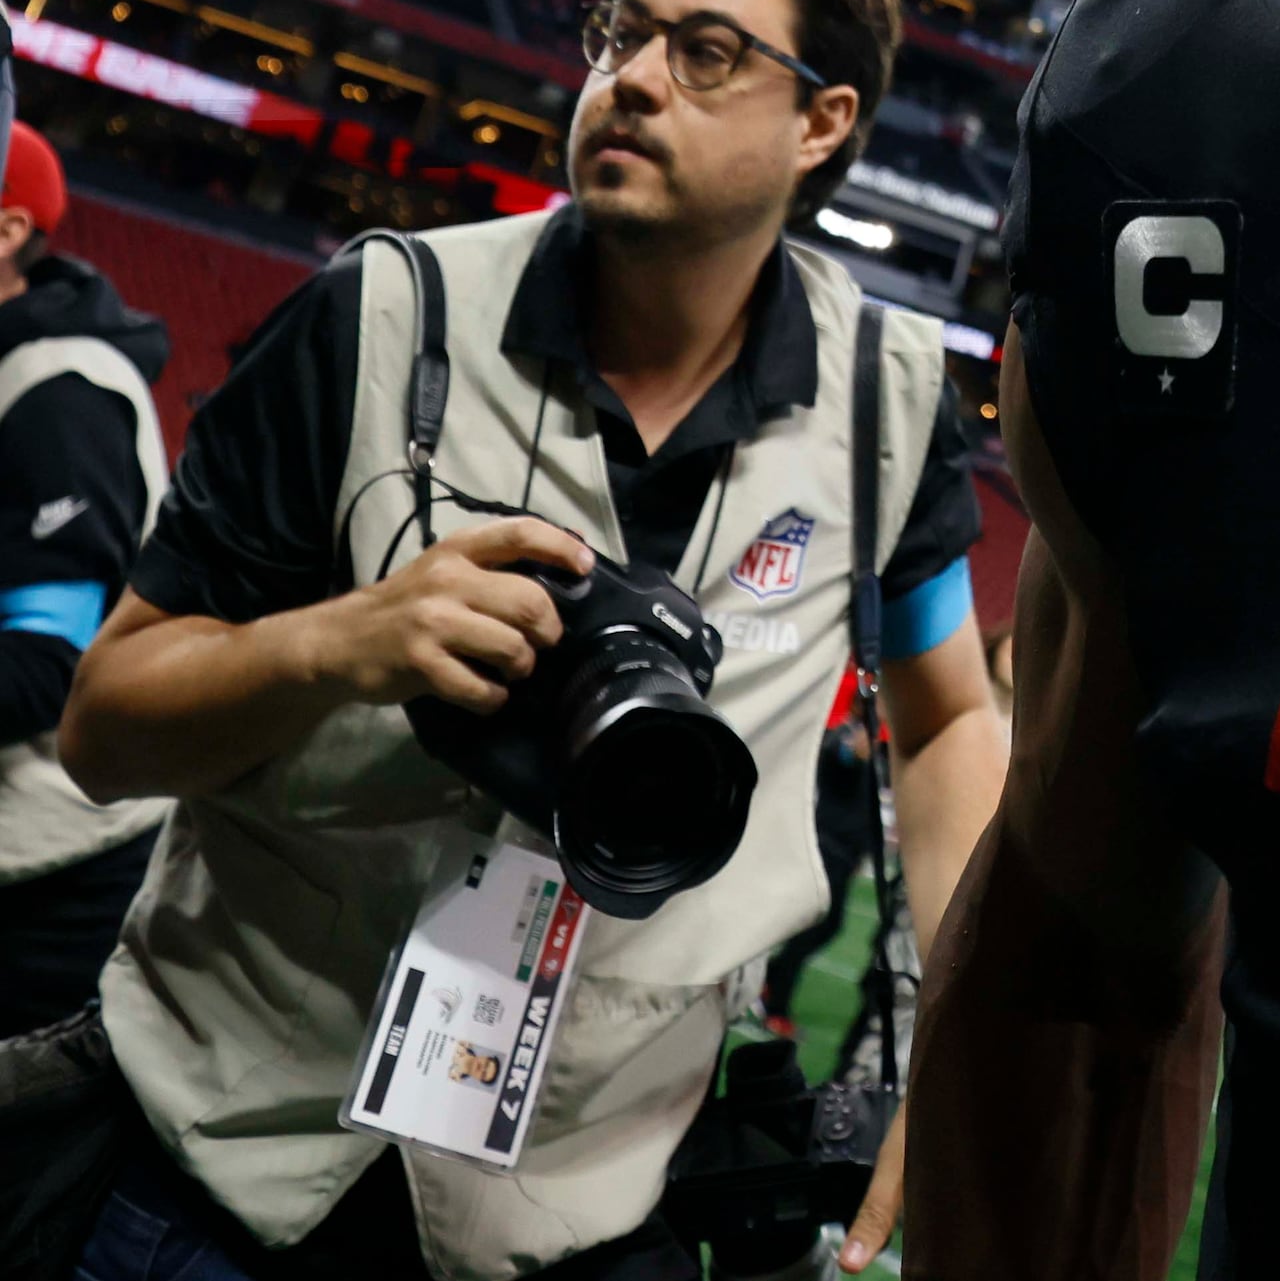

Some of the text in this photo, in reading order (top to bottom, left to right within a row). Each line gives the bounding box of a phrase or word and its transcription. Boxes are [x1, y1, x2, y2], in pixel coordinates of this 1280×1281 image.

[1113, 215, 1225, 360] C
[737, 540, 793, 588] NFL
[651, 601, 695, 641] Canon
[384, 1024, 406, 1057] TEAM
[500, 995, 551, 1122] WEEK 7
